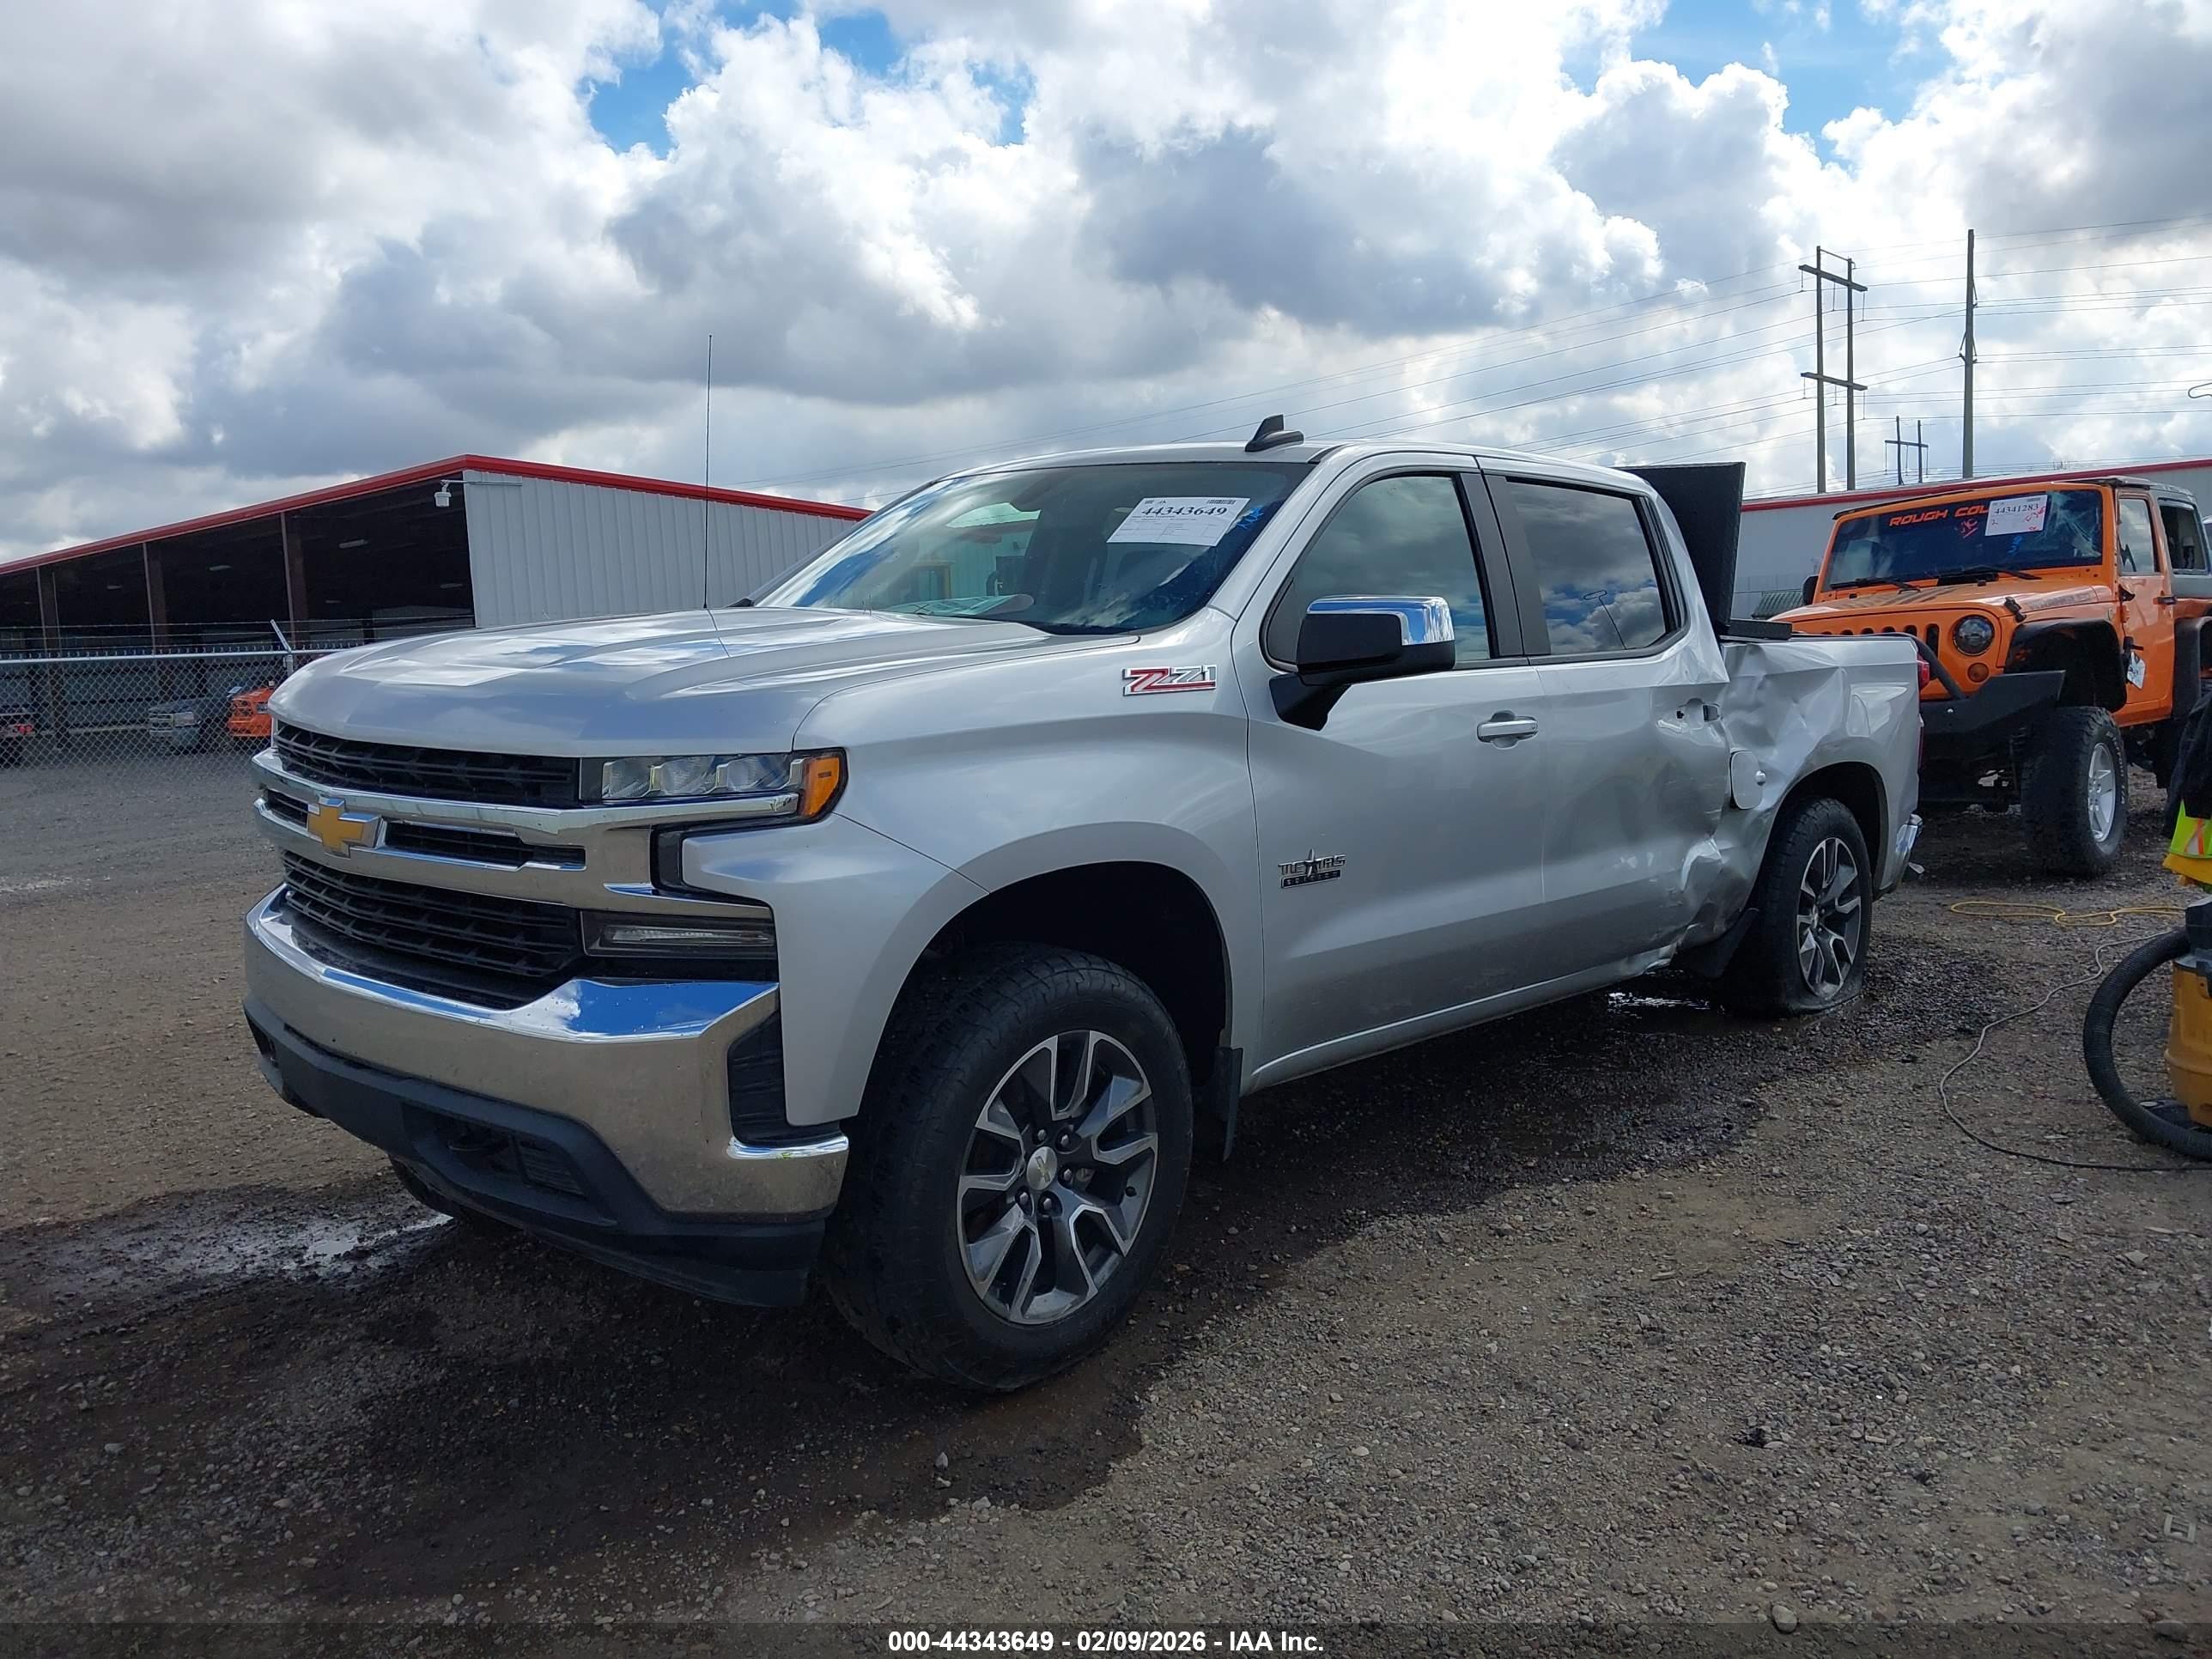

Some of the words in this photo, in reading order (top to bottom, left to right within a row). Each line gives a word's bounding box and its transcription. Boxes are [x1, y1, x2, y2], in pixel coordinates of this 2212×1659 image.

[1141, 507, 1228, 516] 44343649
[1995, 503, 2039, 514] 44341283
[1889, 509, 1948, 526] ROUGH
[1121, 665, 1218, 696] Z71
